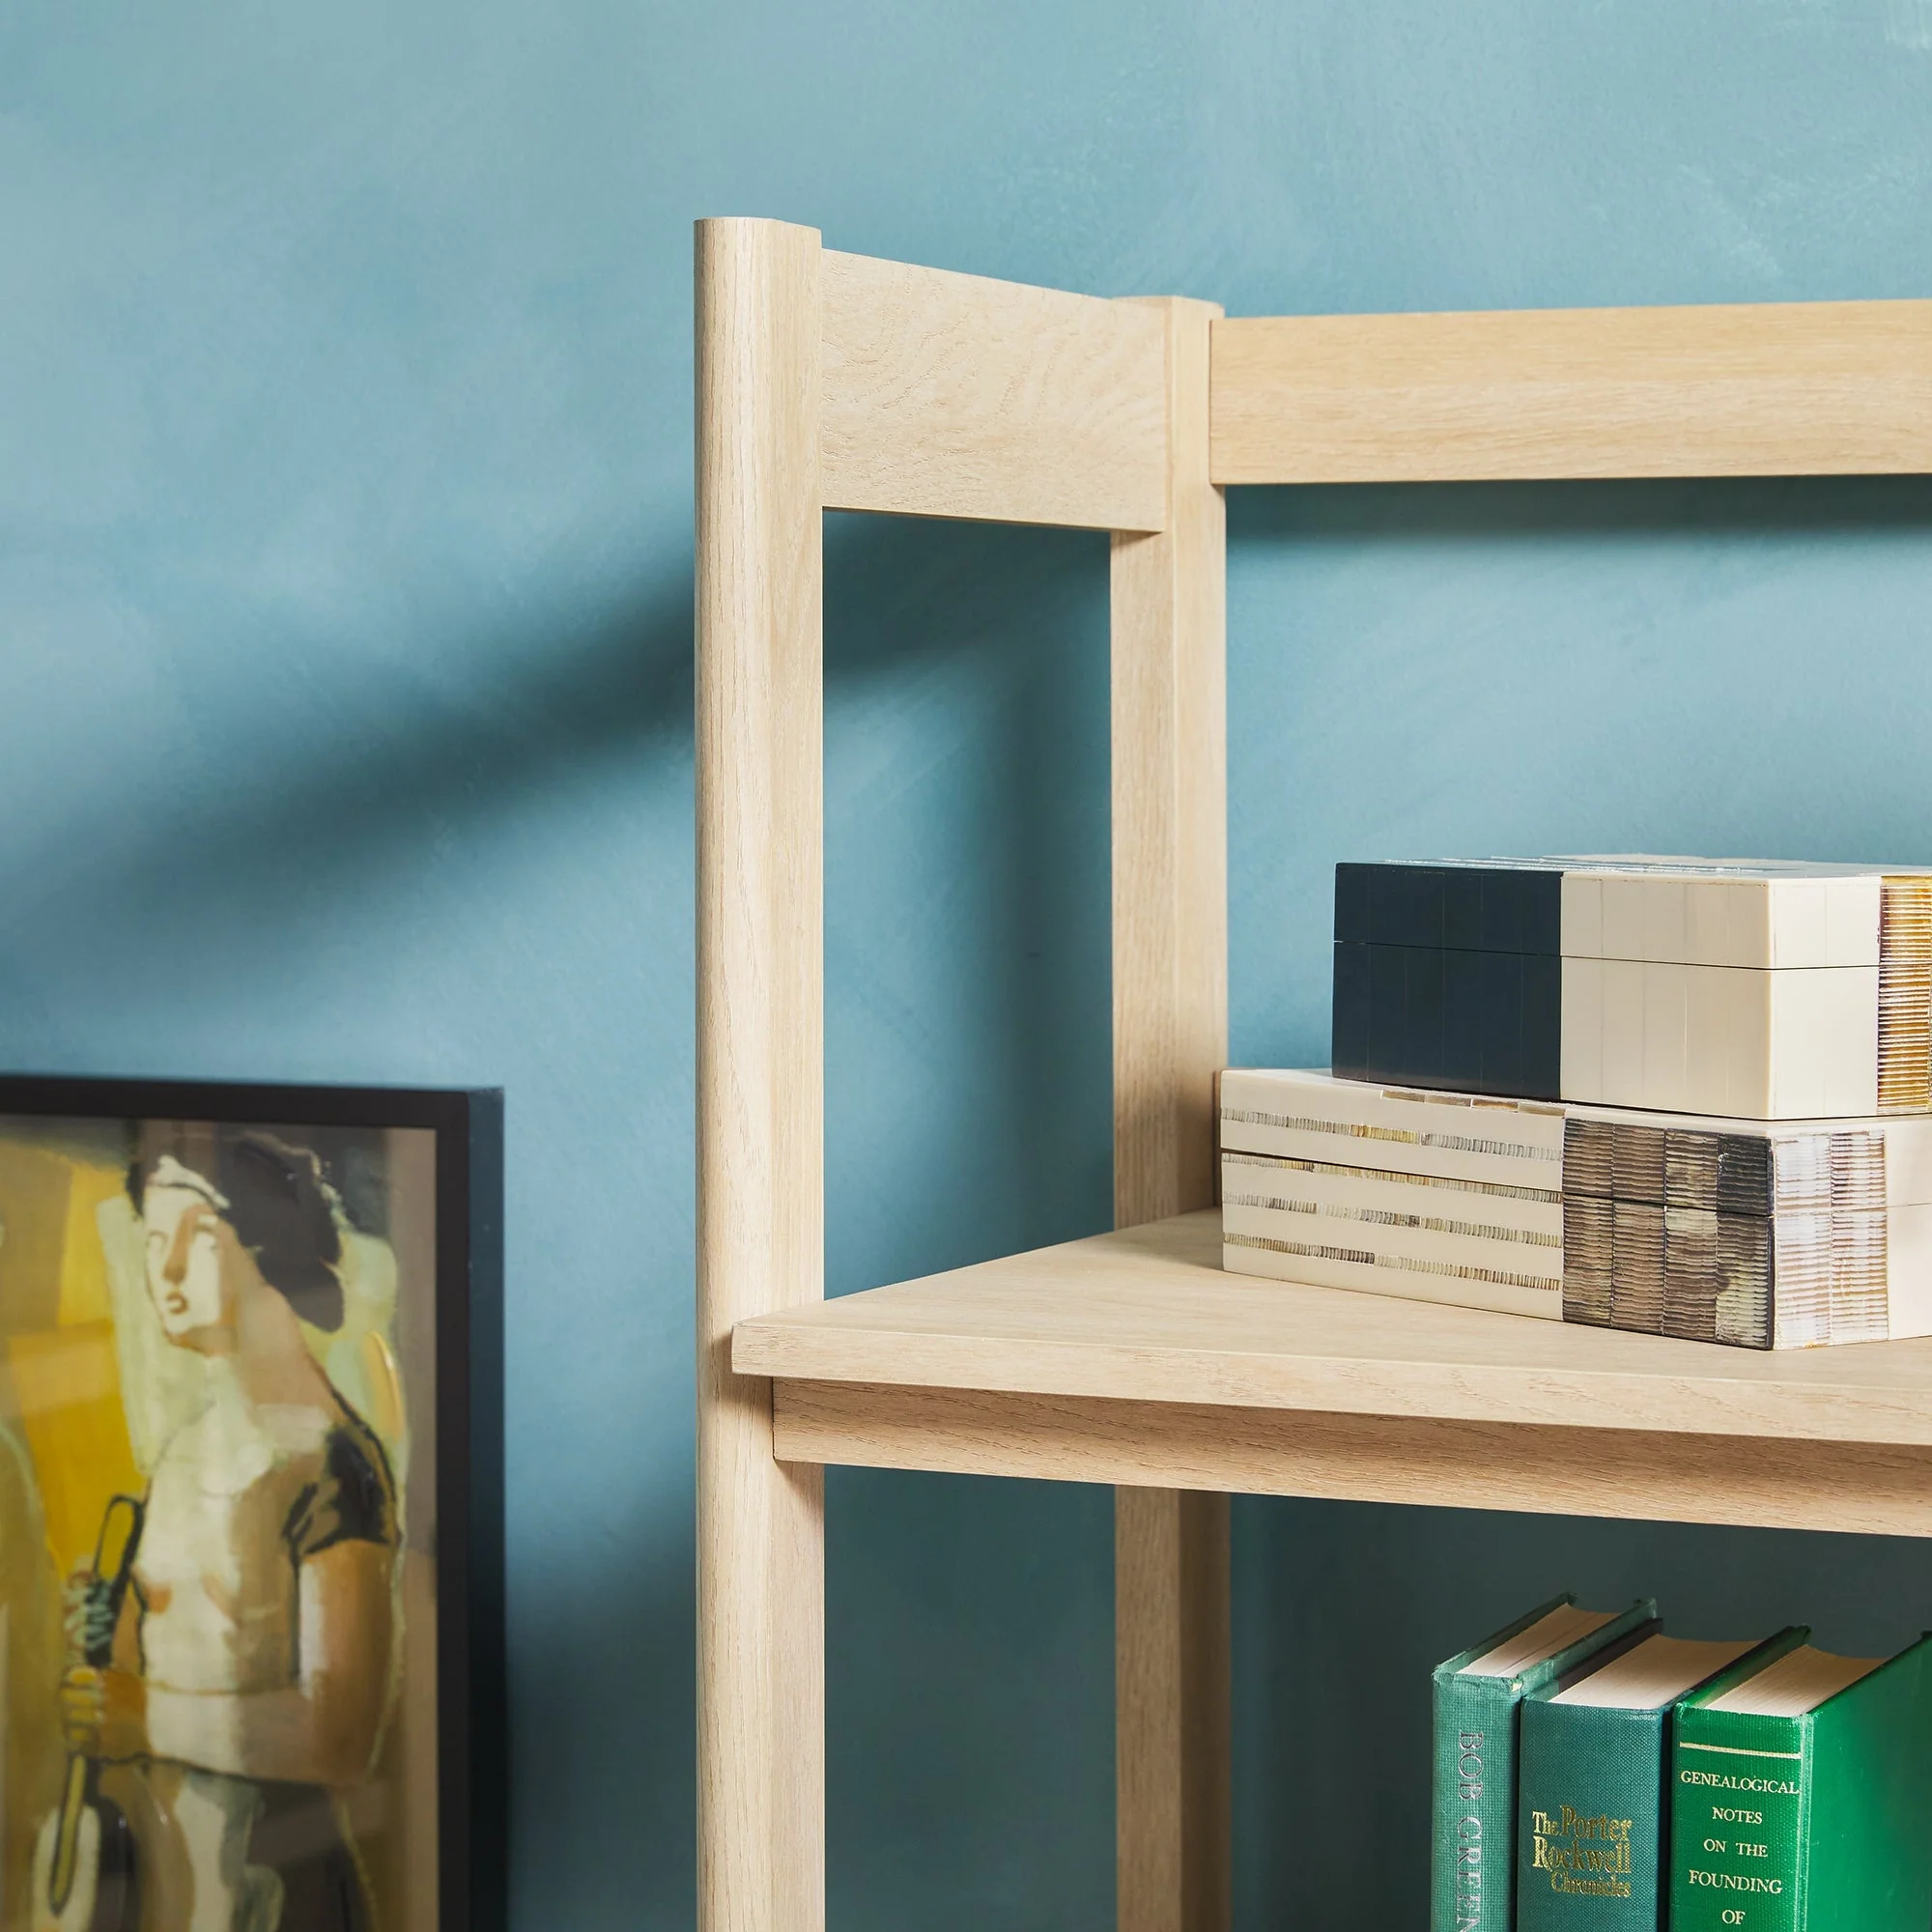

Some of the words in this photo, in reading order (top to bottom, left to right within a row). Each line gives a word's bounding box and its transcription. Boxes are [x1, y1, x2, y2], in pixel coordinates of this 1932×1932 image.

[1459, 1731, 1484, 1801] BOB
[1680, 1770, 1800, 1795] GENEALOGICAL
[1532, 1810, 1558, 1835] The
[1560, 1804, 1633, 1841] Porter
[1712, 1806, 1763, 1825] NOTES
[1532, 1835, 1633, 1874] Rockwell
[1703, 1838, 1726, 1853] ON
[1735, 1842, 1769, 1858] THE
[1550, 1870, 1632, 1898] Chronicles
[1689, 1869, 1783, 1894] FOUNDING
[1721, 1909, 1747, 1925] OF
